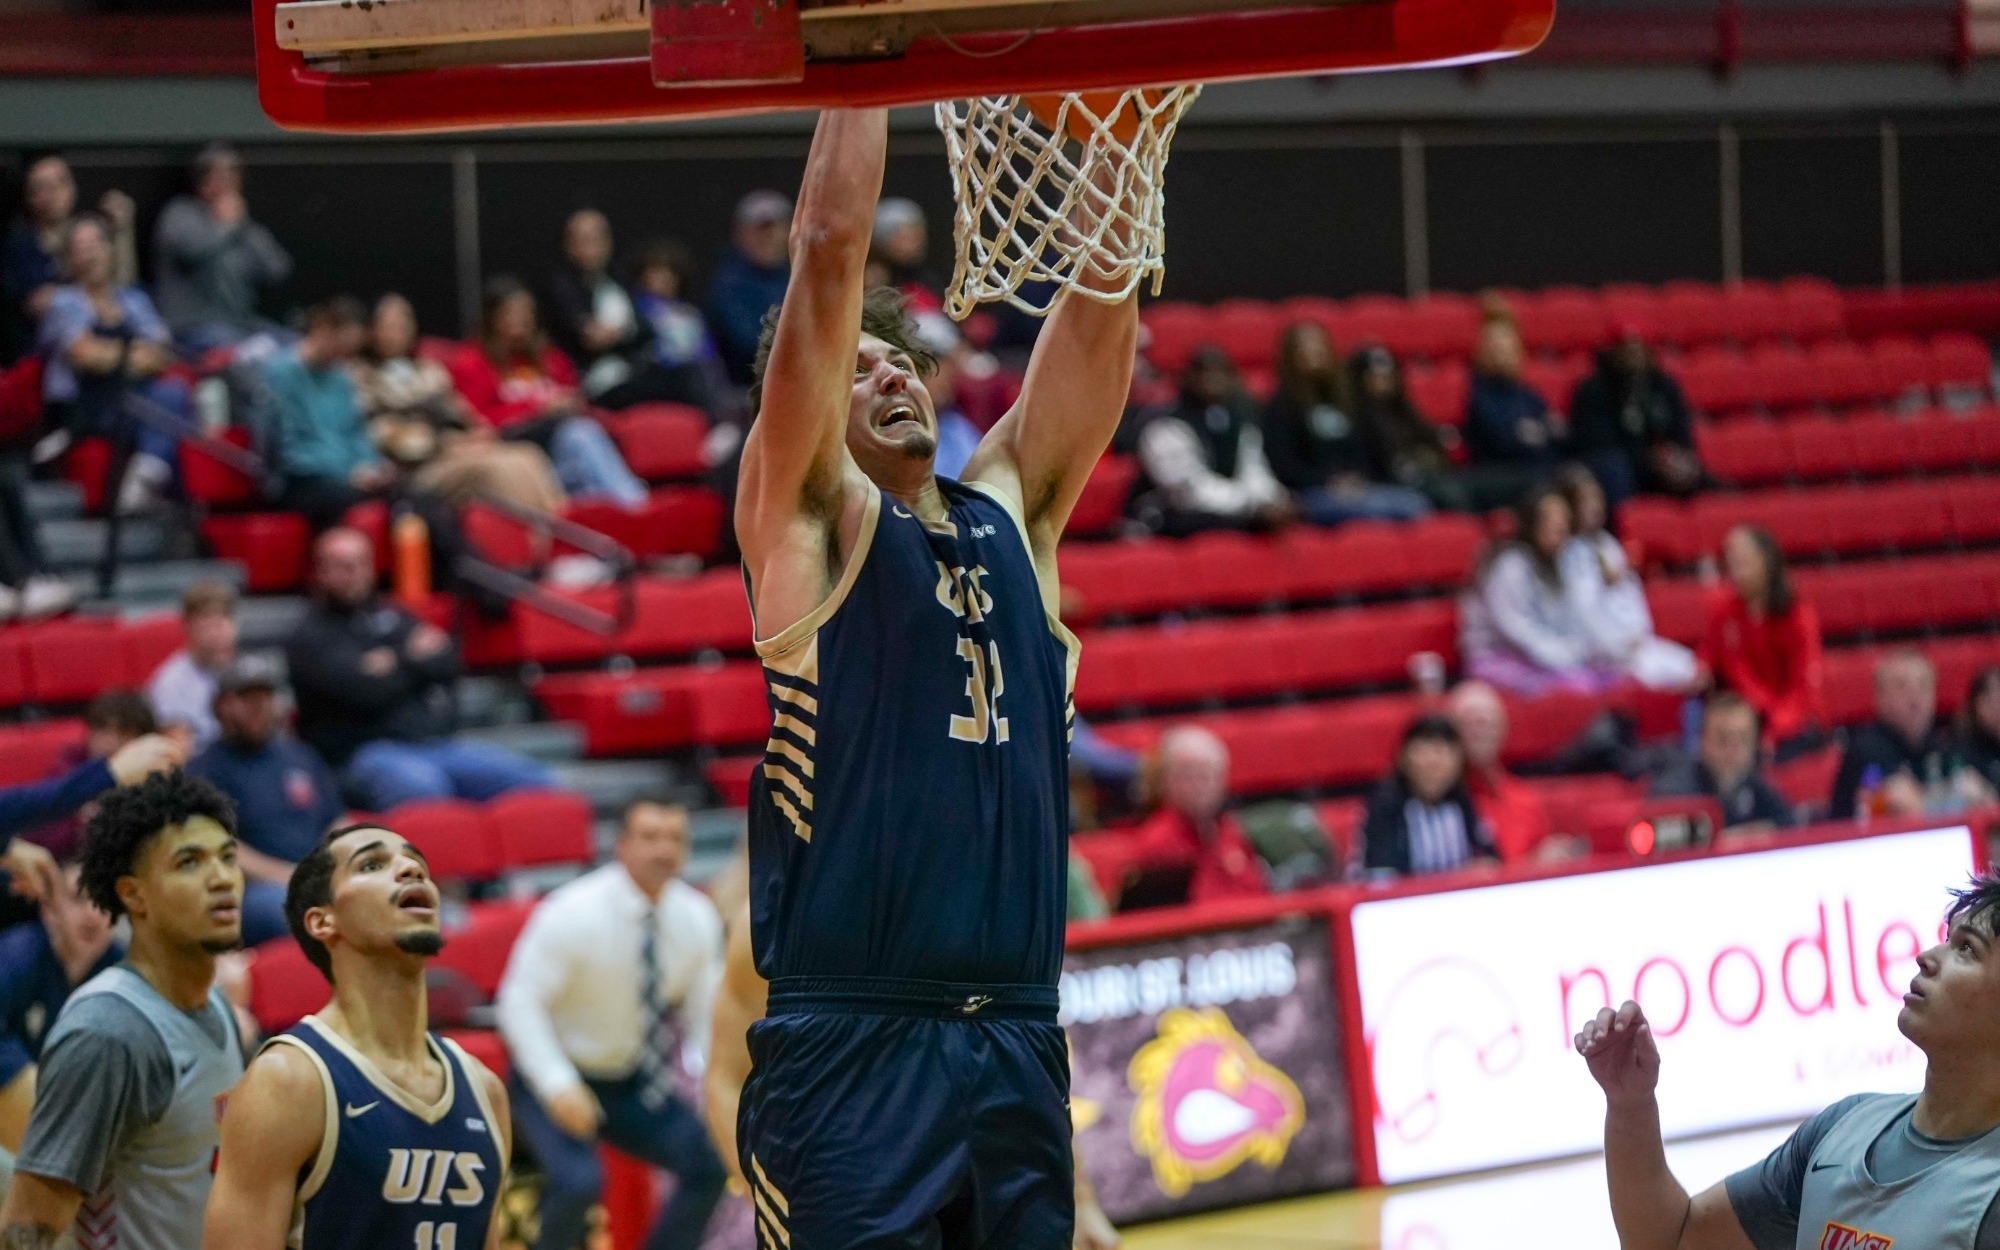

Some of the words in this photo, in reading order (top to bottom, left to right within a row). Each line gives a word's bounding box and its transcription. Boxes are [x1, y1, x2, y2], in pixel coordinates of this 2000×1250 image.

[1186, 942, 1297, 1007] LOUIS
[1558, 897, 1948, 1051] noodle
[382, 1148, 487, 1206] UIS
